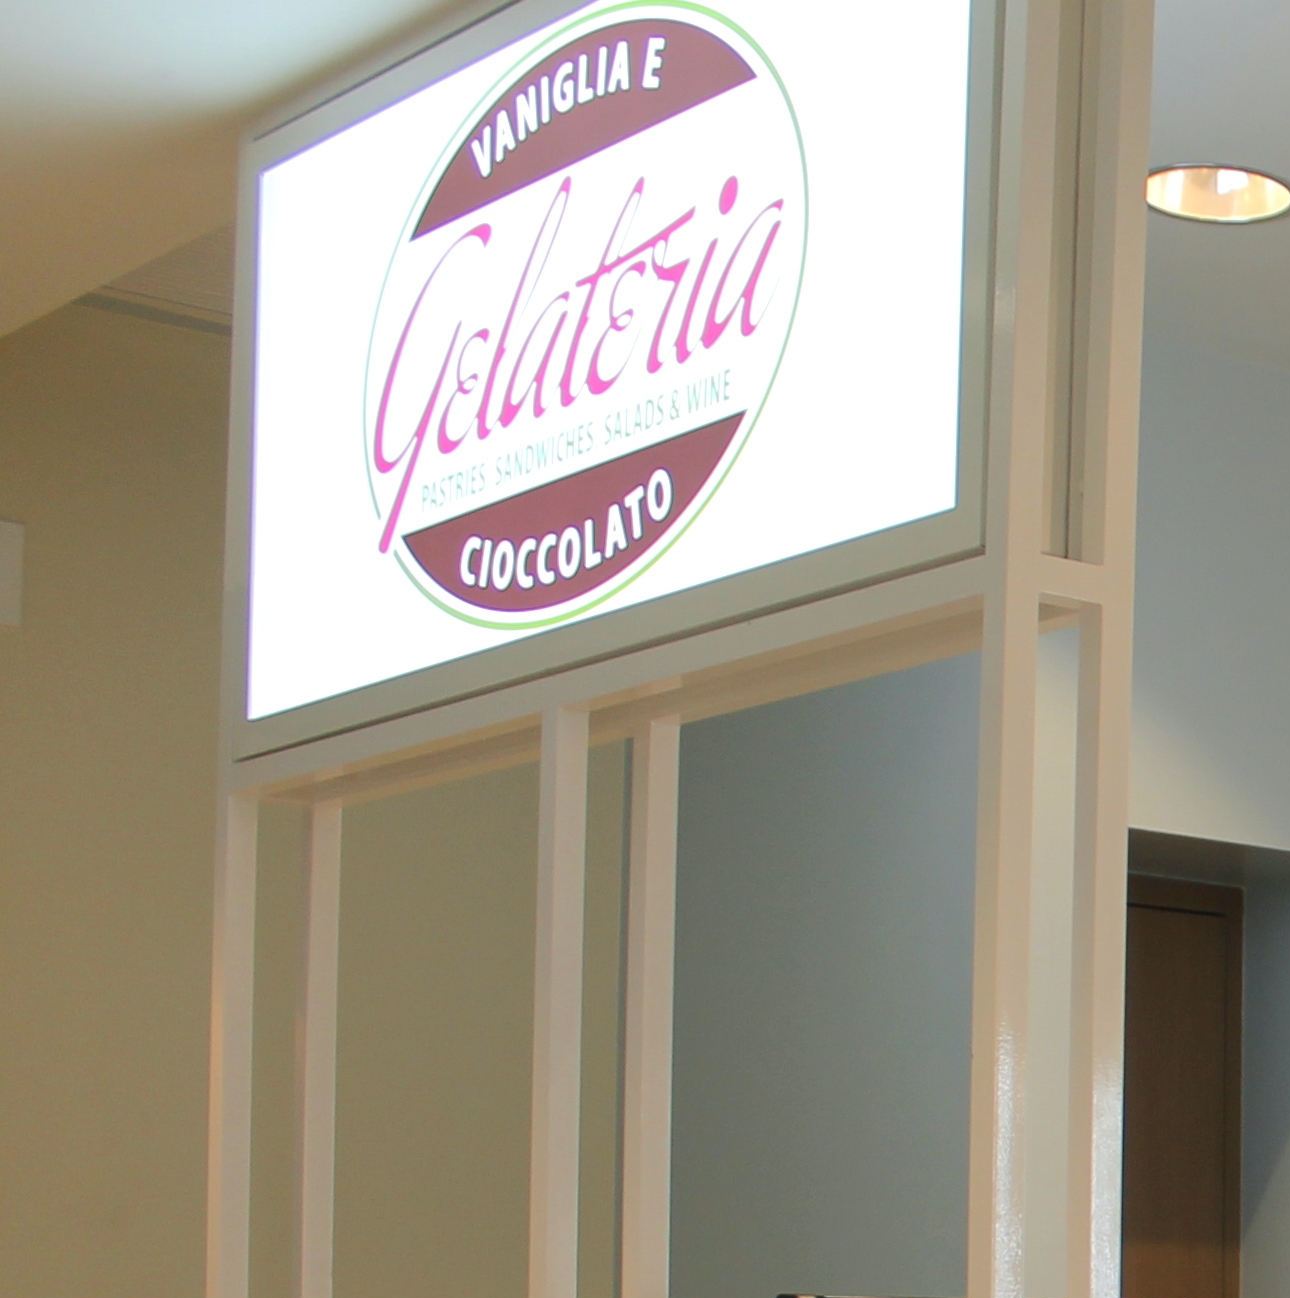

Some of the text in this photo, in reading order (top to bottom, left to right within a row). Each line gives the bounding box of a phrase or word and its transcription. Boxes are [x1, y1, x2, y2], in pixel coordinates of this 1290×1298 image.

[470, 35, 667, 178] VANIGLIA E
[373, 175, 785, 555] Gelateria
[604, 394, 664, 446] SALADS
[669, 389, 681, 420] &
[687, 368, 731, 414] WINE
[459, 467, 673, 590] CIOCCOLATO
